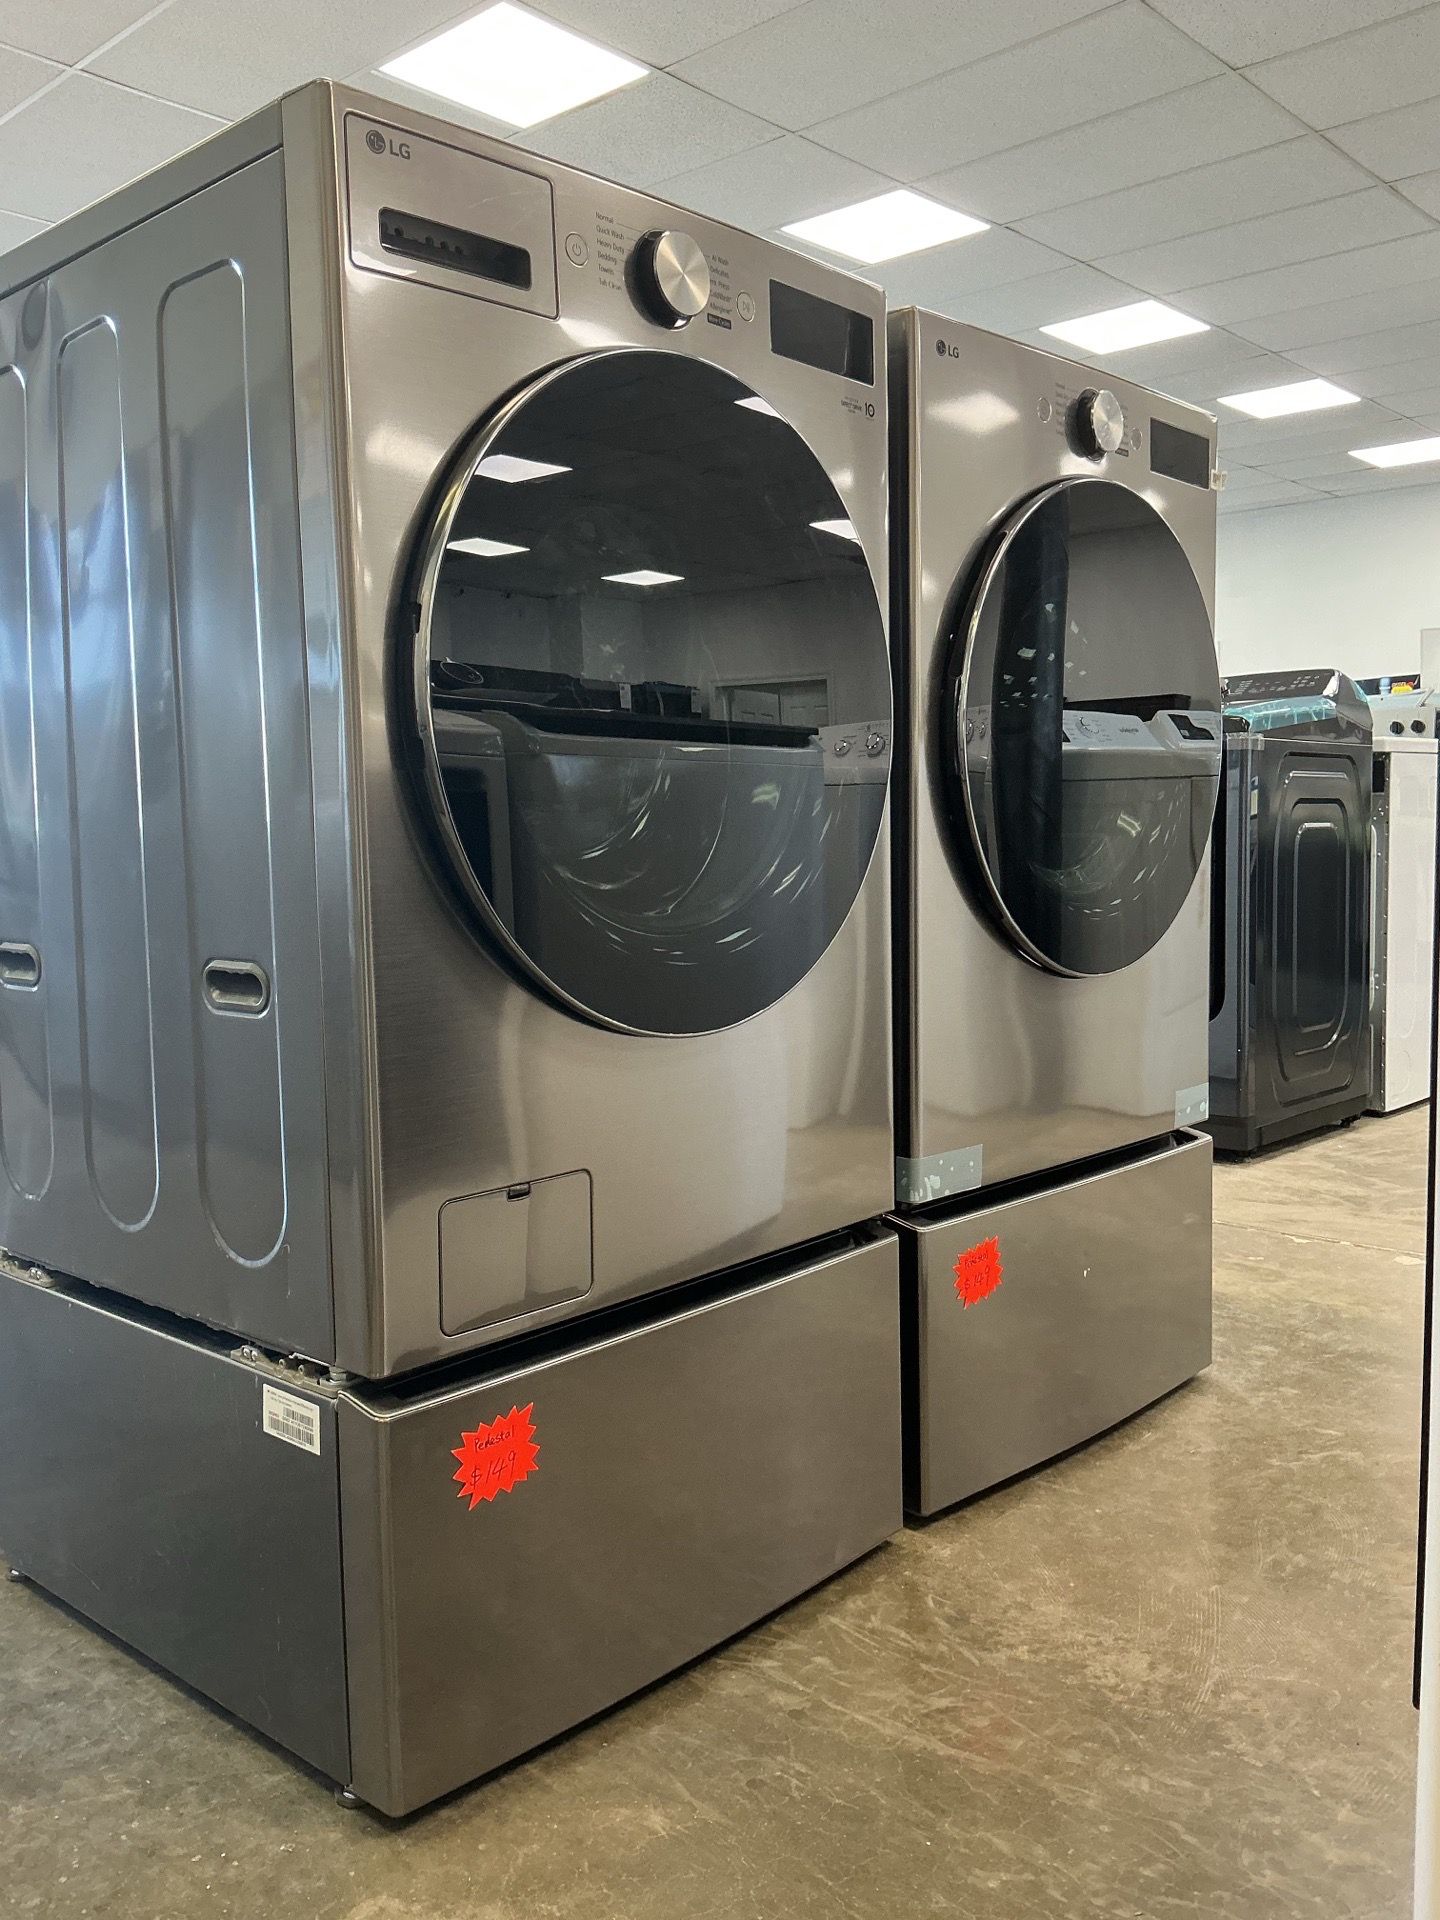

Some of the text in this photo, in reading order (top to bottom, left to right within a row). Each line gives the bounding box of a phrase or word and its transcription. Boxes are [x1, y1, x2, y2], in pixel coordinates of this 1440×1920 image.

[389, 139, 411, 160] LG
[595, 211, 614, 224] Normal
[611, 230, 625, 240] Wash
[597, 238, 612, 249] Heavy
[597, 250, 617, 266] Bedding
[947, 344, 960, 359] LG
[474, 1424, 516, 1453] Pedestal
[470, 1450, 517, 1490] $149
